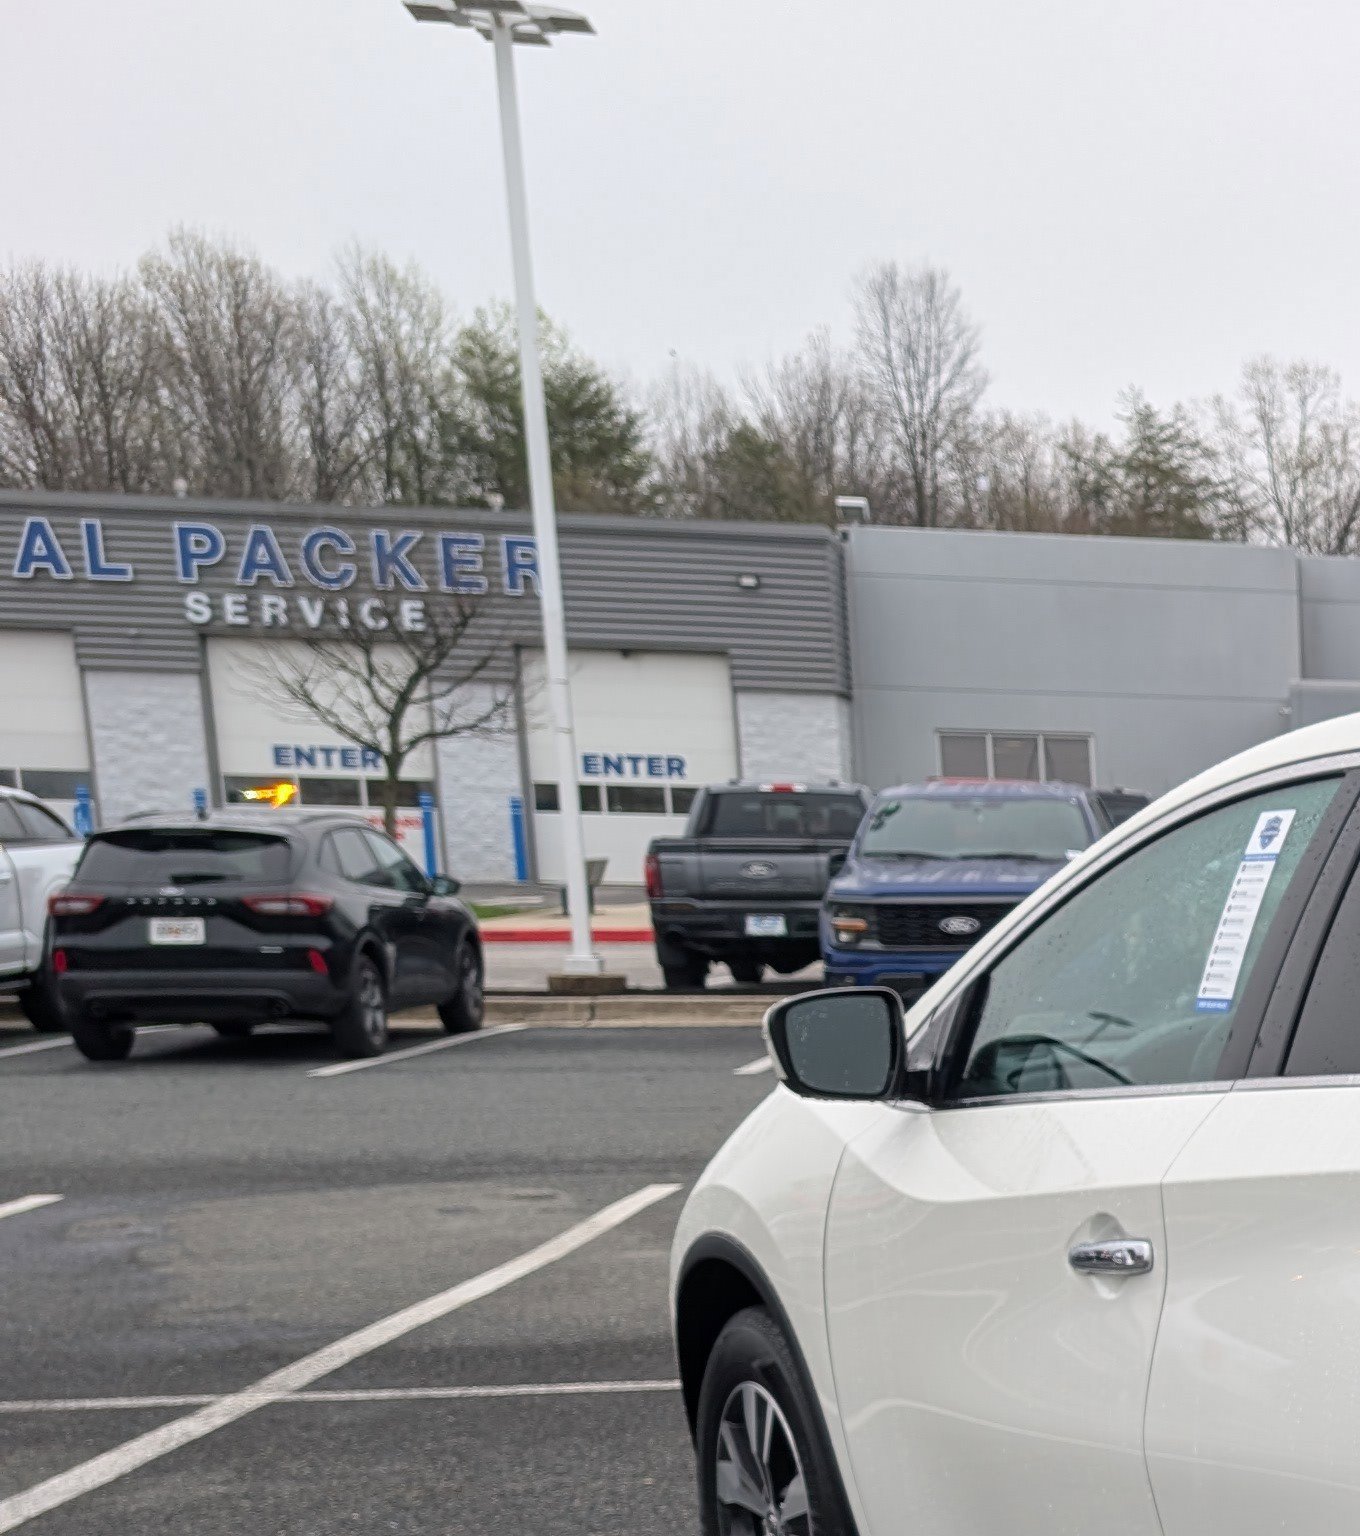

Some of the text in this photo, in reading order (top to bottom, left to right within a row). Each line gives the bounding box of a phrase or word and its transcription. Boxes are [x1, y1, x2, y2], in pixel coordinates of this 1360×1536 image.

[13, 517, 543, 597] AL PACKER
[184, 591, 427, 633] SERVICE
[274, 743, 384, 770] ENTER
[582, 753, 686, 778] ENTER
